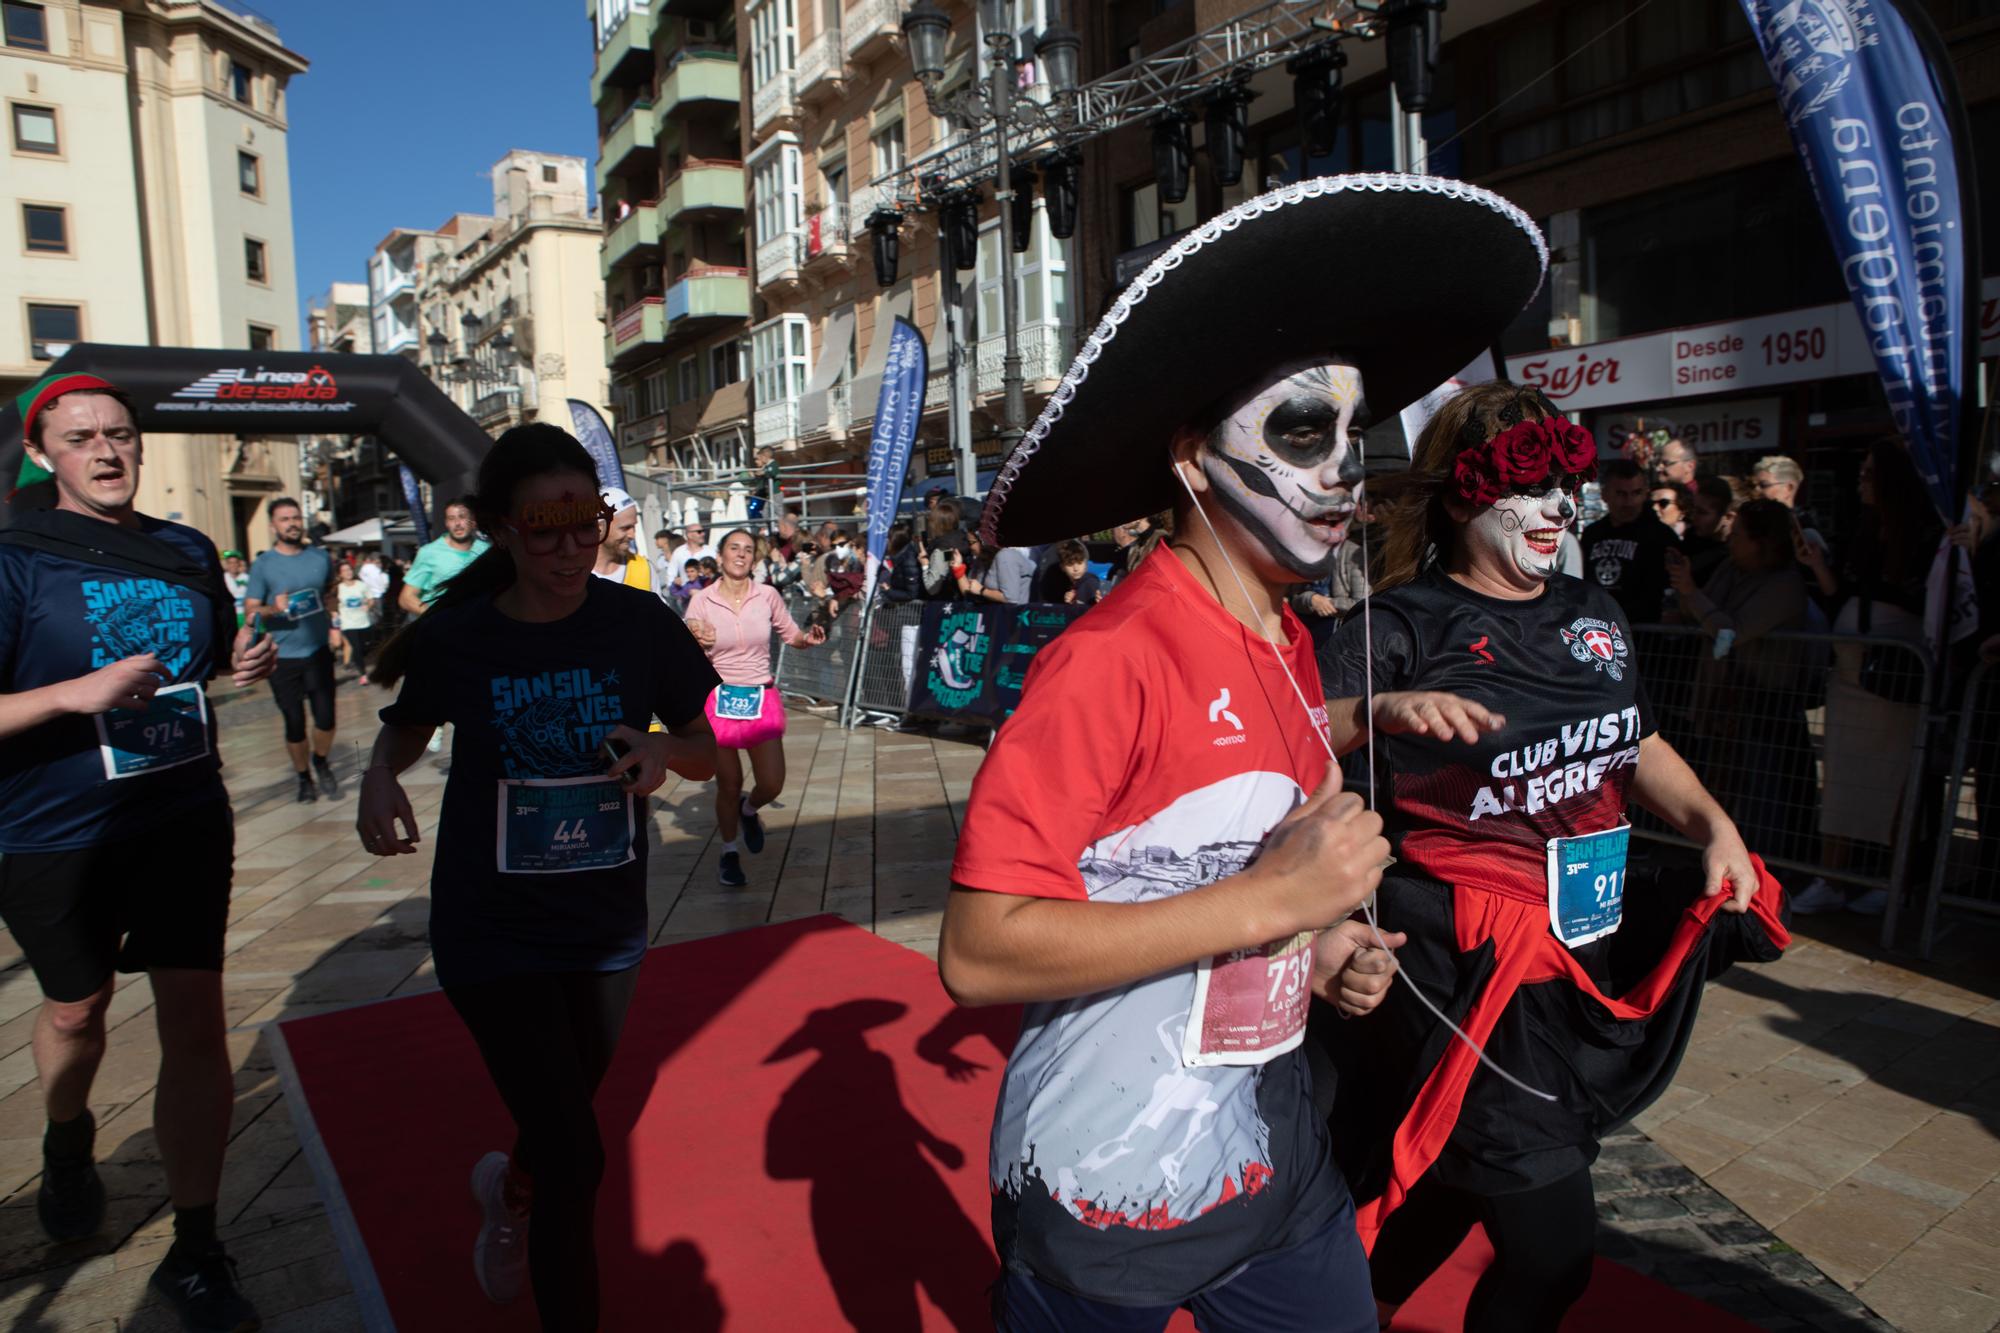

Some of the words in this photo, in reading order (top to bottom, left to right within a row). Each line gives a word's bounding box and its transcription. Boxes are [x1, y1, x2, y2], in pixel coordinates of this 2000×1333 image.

[1677, 334, 1744, 359] Desde
[1761, 327, 1826, 366] 1950
[1677, 363, 1736, 385] Since
[156, 599, 194, 620] VES
[153, 621, 190, 643] TRE
[576, 695, 624, 723] VES
[730, 697, 749, 708] 733
[143, 719, 185, 746] 974
[1491, 738, 1559, 779] CLUB
[1560, 703, 1641, 758] VIST
[597, 801, 620, 812] 2022
[553, 818, 587, 843] 44
[1565, 841, 1594, 862] SAN
[1594, 867, 1626, 903] 911
[1266, 947, 1312, 1003] 739
